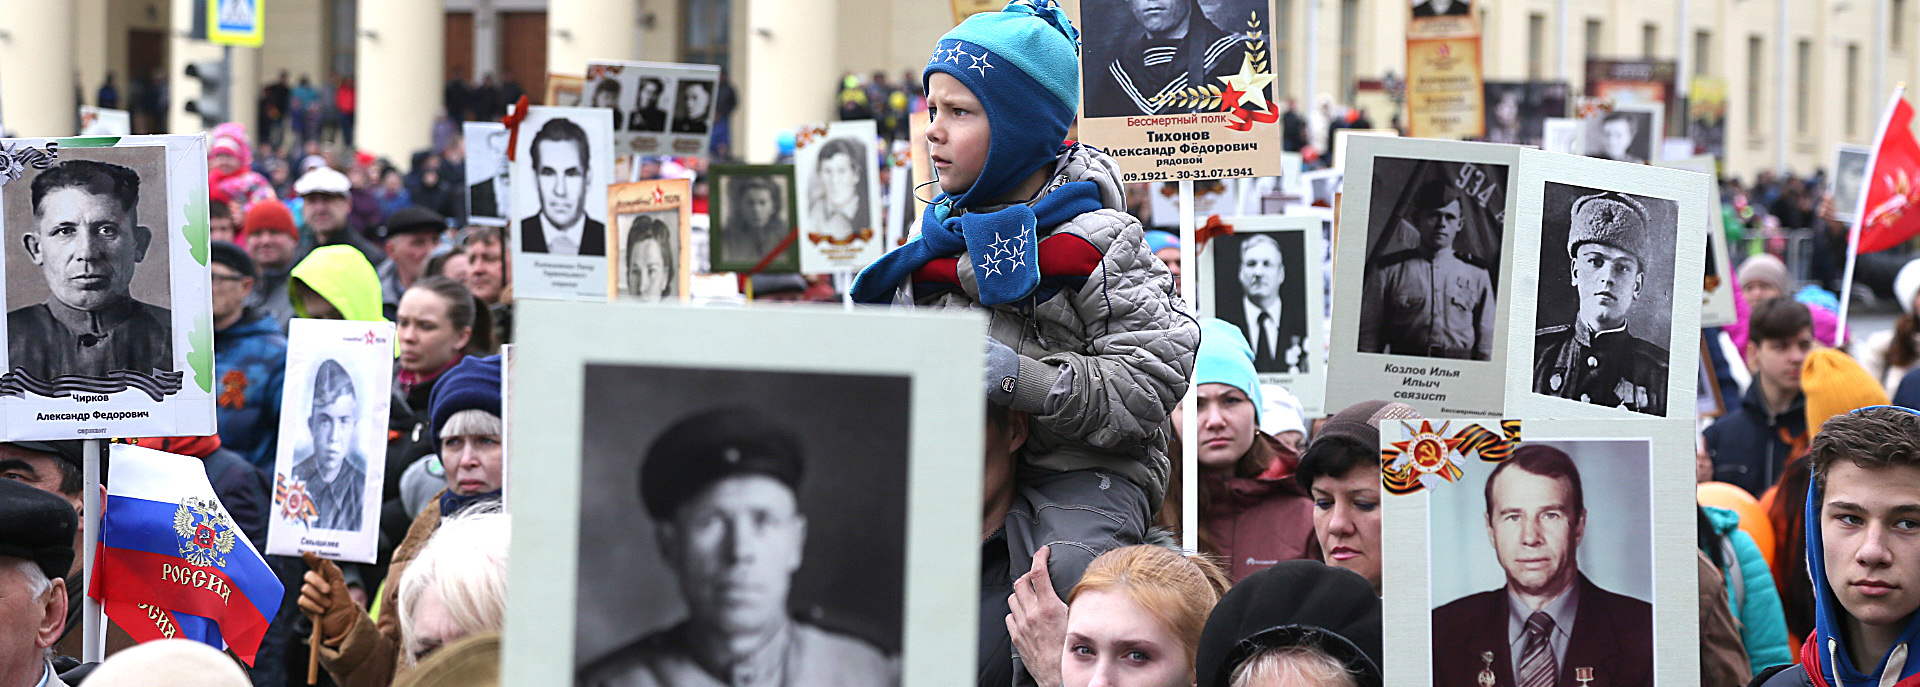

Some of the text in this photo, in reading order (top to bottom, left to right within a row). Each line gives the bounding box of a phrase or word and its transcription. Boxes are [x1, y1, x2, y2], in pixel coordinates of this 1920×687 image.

[1127, 114, 1227, 127] Бессмертный полк
[1146, 131, 1211, 143] Тихонов
[1103, 142, 1258, 158] Александр Фёдорович
[1156, 156, 1203, 167] рядовой
[1121, 172, 1168, 183] .09.1921
[1176, 167, 1254, 180] 30-31.07.1941
[1384, 364, 1460, 378] Козлов Илья
[1402, 377, 1441, 388] Ильич
[72, 394, 110, 404] Чирков
[1393, 391, 1447, 402] связист
[36, 411, 149, 422] Александр Федорович
[161, 563, 233, 607] РОССИЯ
[138, 602, 177, 641] СИЯ
